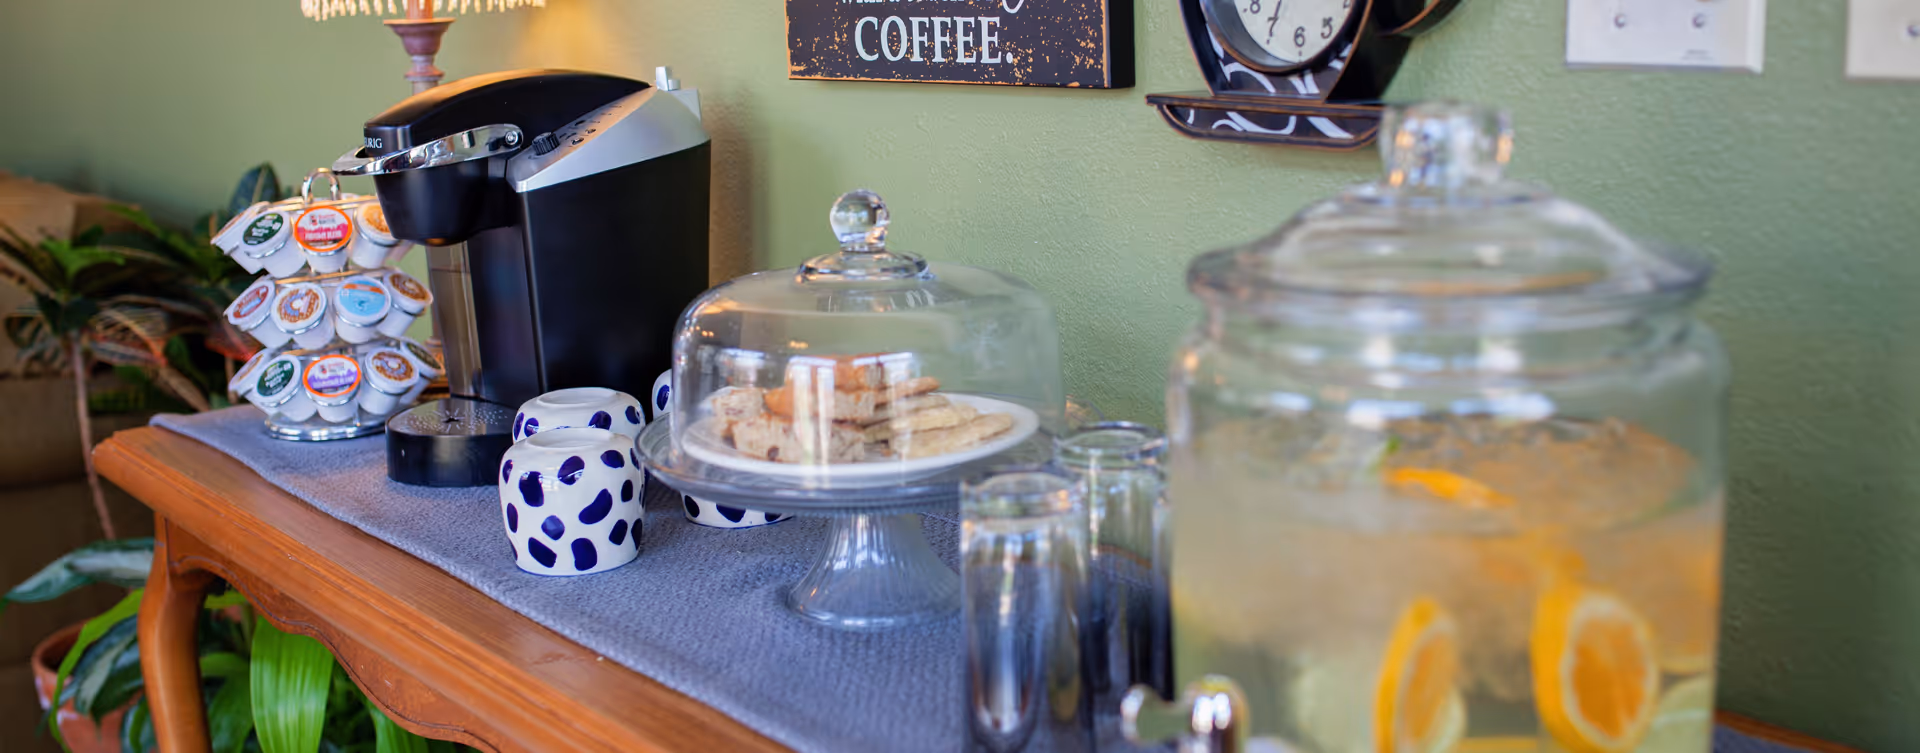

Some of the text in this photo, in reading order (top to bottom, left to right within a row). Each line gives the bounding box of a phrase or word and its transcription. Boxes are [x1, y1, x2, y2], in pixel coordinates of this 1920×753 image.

[1267, 16, 1279, 37] 7
[1294, 26, 1305, 48] 6
[1320, 17, 1333, 39] 5
[854, 16, 1014, 64] COFFEE.
[364, 136, 383, 149] URIG
